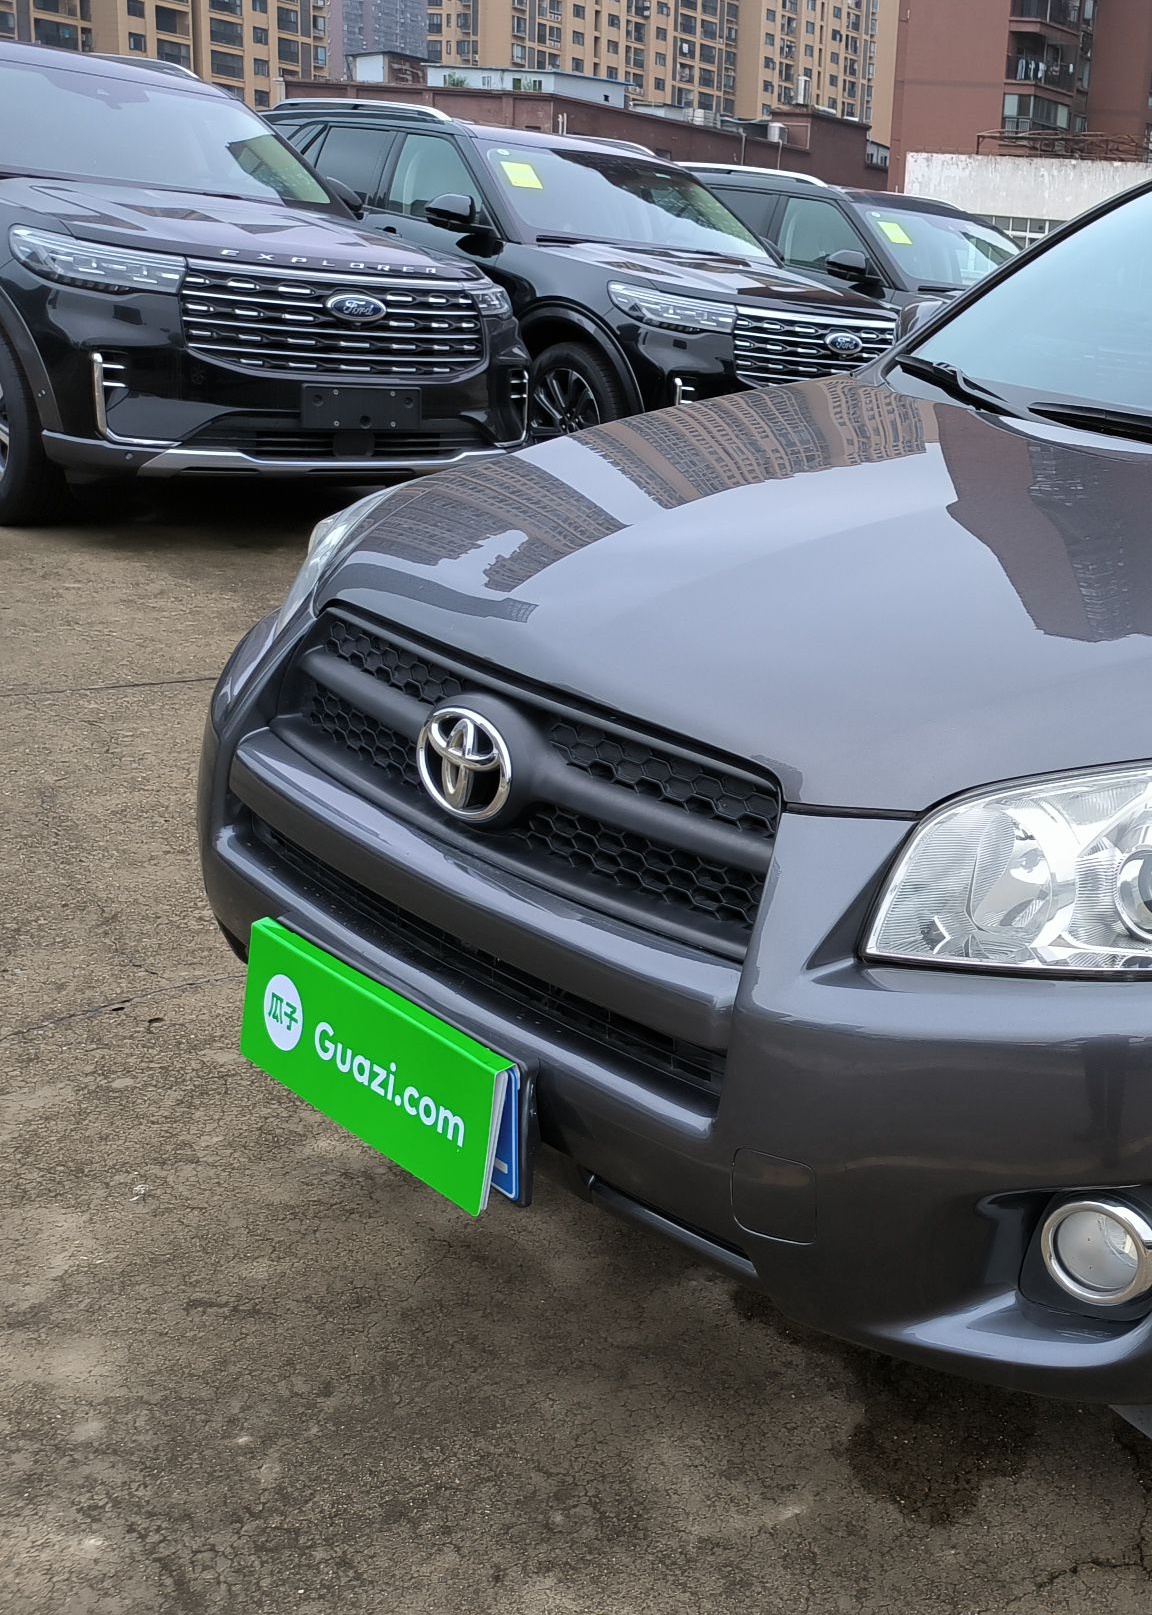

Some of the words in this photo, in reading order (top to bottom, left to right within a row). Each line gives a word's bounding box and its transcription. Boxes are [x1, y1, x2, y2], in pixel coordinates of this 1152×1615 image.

[220, 250, 437, 274] EXPLORER
[343, 300, 374, 316] Ford
[268, 992, 298, 1031] 瓜子
[314, 1021, 465, 1148] Guazi.com
